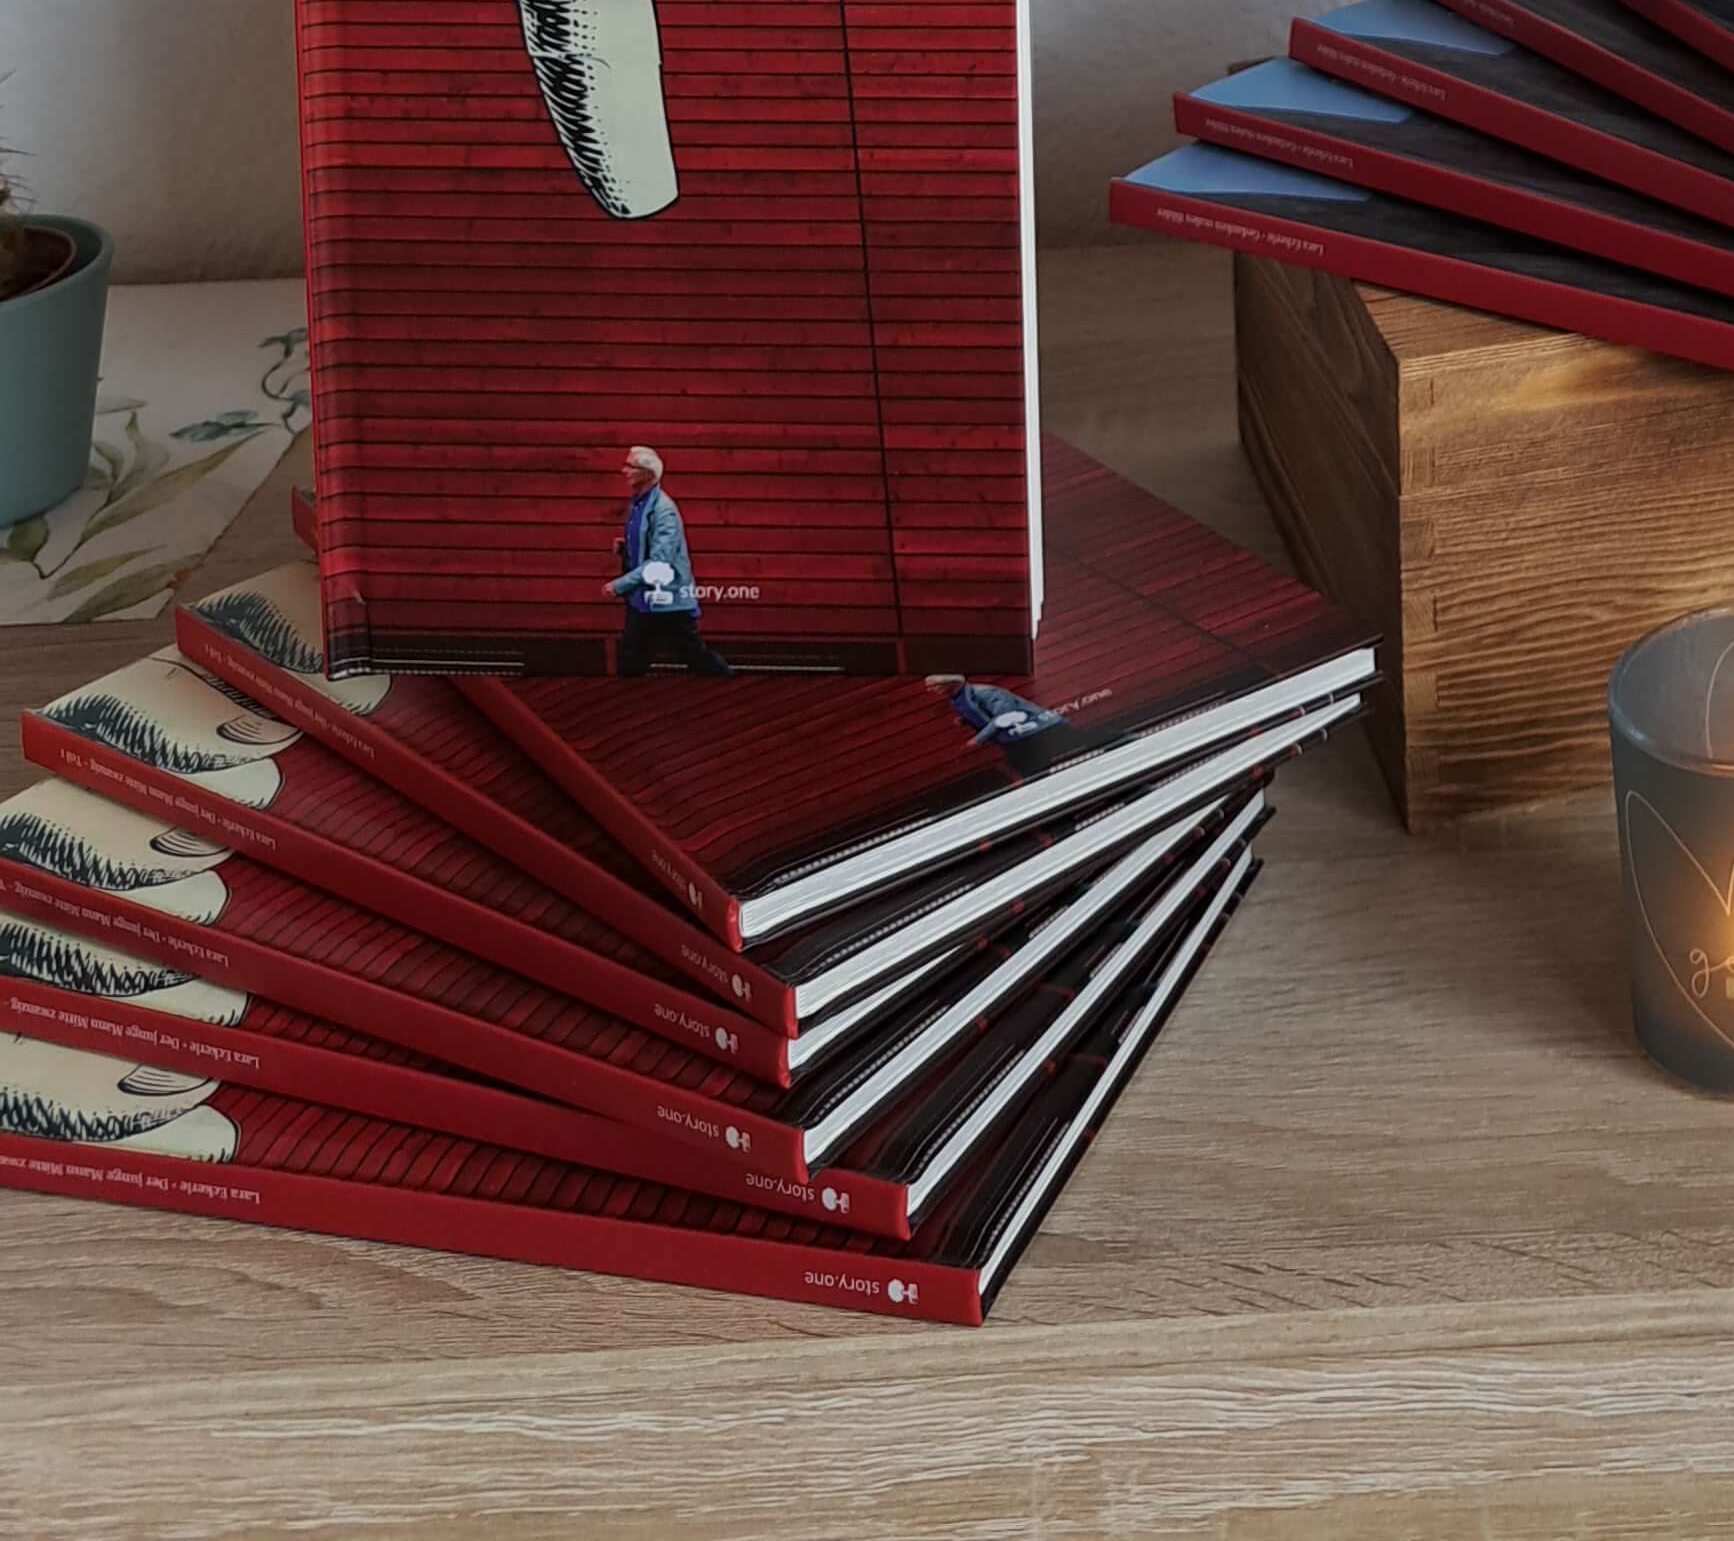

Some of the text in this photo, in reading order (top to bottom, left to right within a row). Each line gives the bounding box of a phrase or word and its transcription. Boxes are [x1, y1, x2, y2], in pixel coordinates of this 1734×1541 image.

[679, 581, 761, 603] story.one
[654, 1002, 711, 1042] story.one
[10, 996, 260, 1070] Lara Eckerle Der junge Mann Mitte zwanzig
[657, 1104, 720, 1140] story.one
[29, 1157, 64, 1176] Mitte
[65, 1162, 104, 1182] Mann
[106, 1168, 144, 1188] junge
[146, 1176, 169, 1192] Der
[745, 1171, 816, 1205] story.one
[180, 1179, 228, 1199] Eckerle
[230, 1188, 261, 1206] Lara
[803, 1270, 881, 1298] story.one
